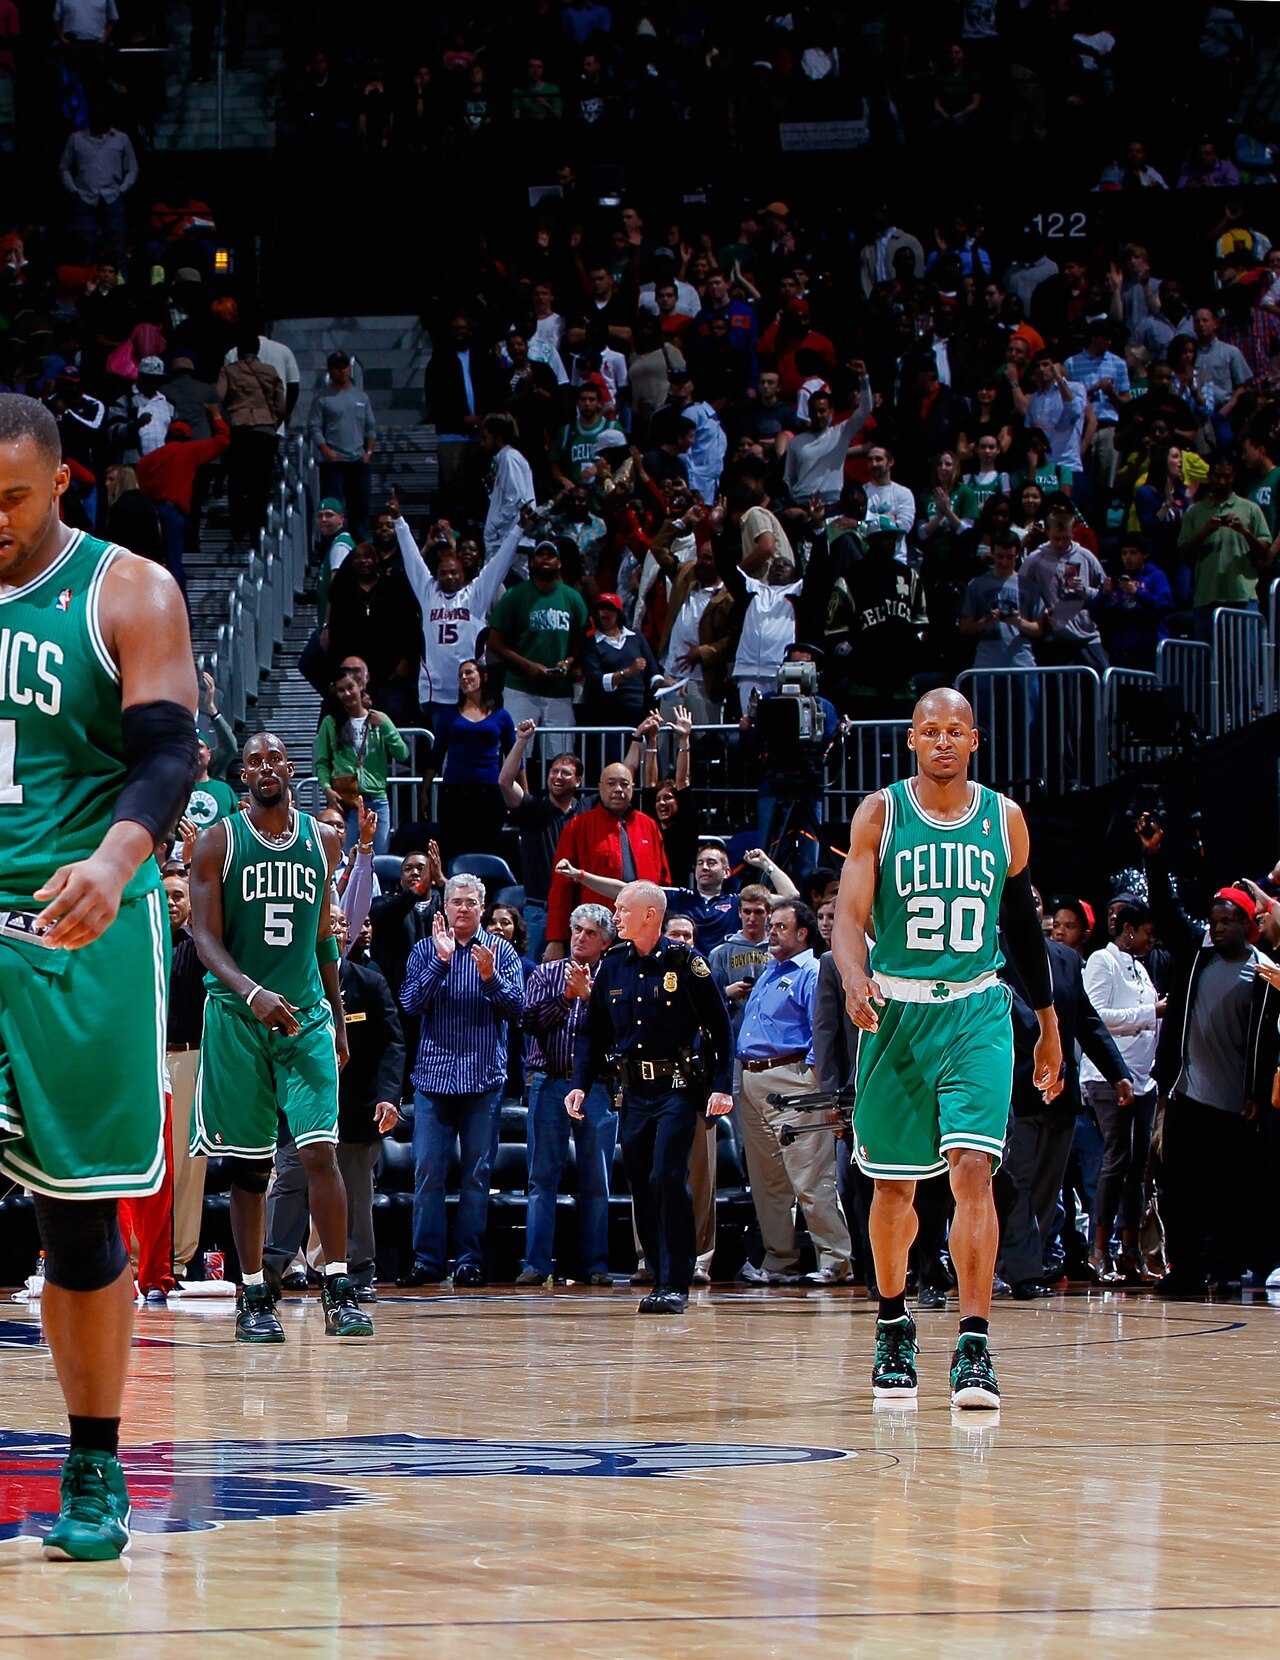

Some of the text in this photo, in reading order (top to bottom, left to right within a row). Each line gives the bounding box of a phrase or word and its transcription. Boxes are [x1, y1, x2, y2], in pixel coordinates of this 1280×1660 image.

[438, 624, 459, 644] 15
[242, 861, 317, 904] CELTICS
[895, 842, 995, 897] CELTICS
[264, 902, 295, 946] 5
[906, 896, 986, 952] 20
